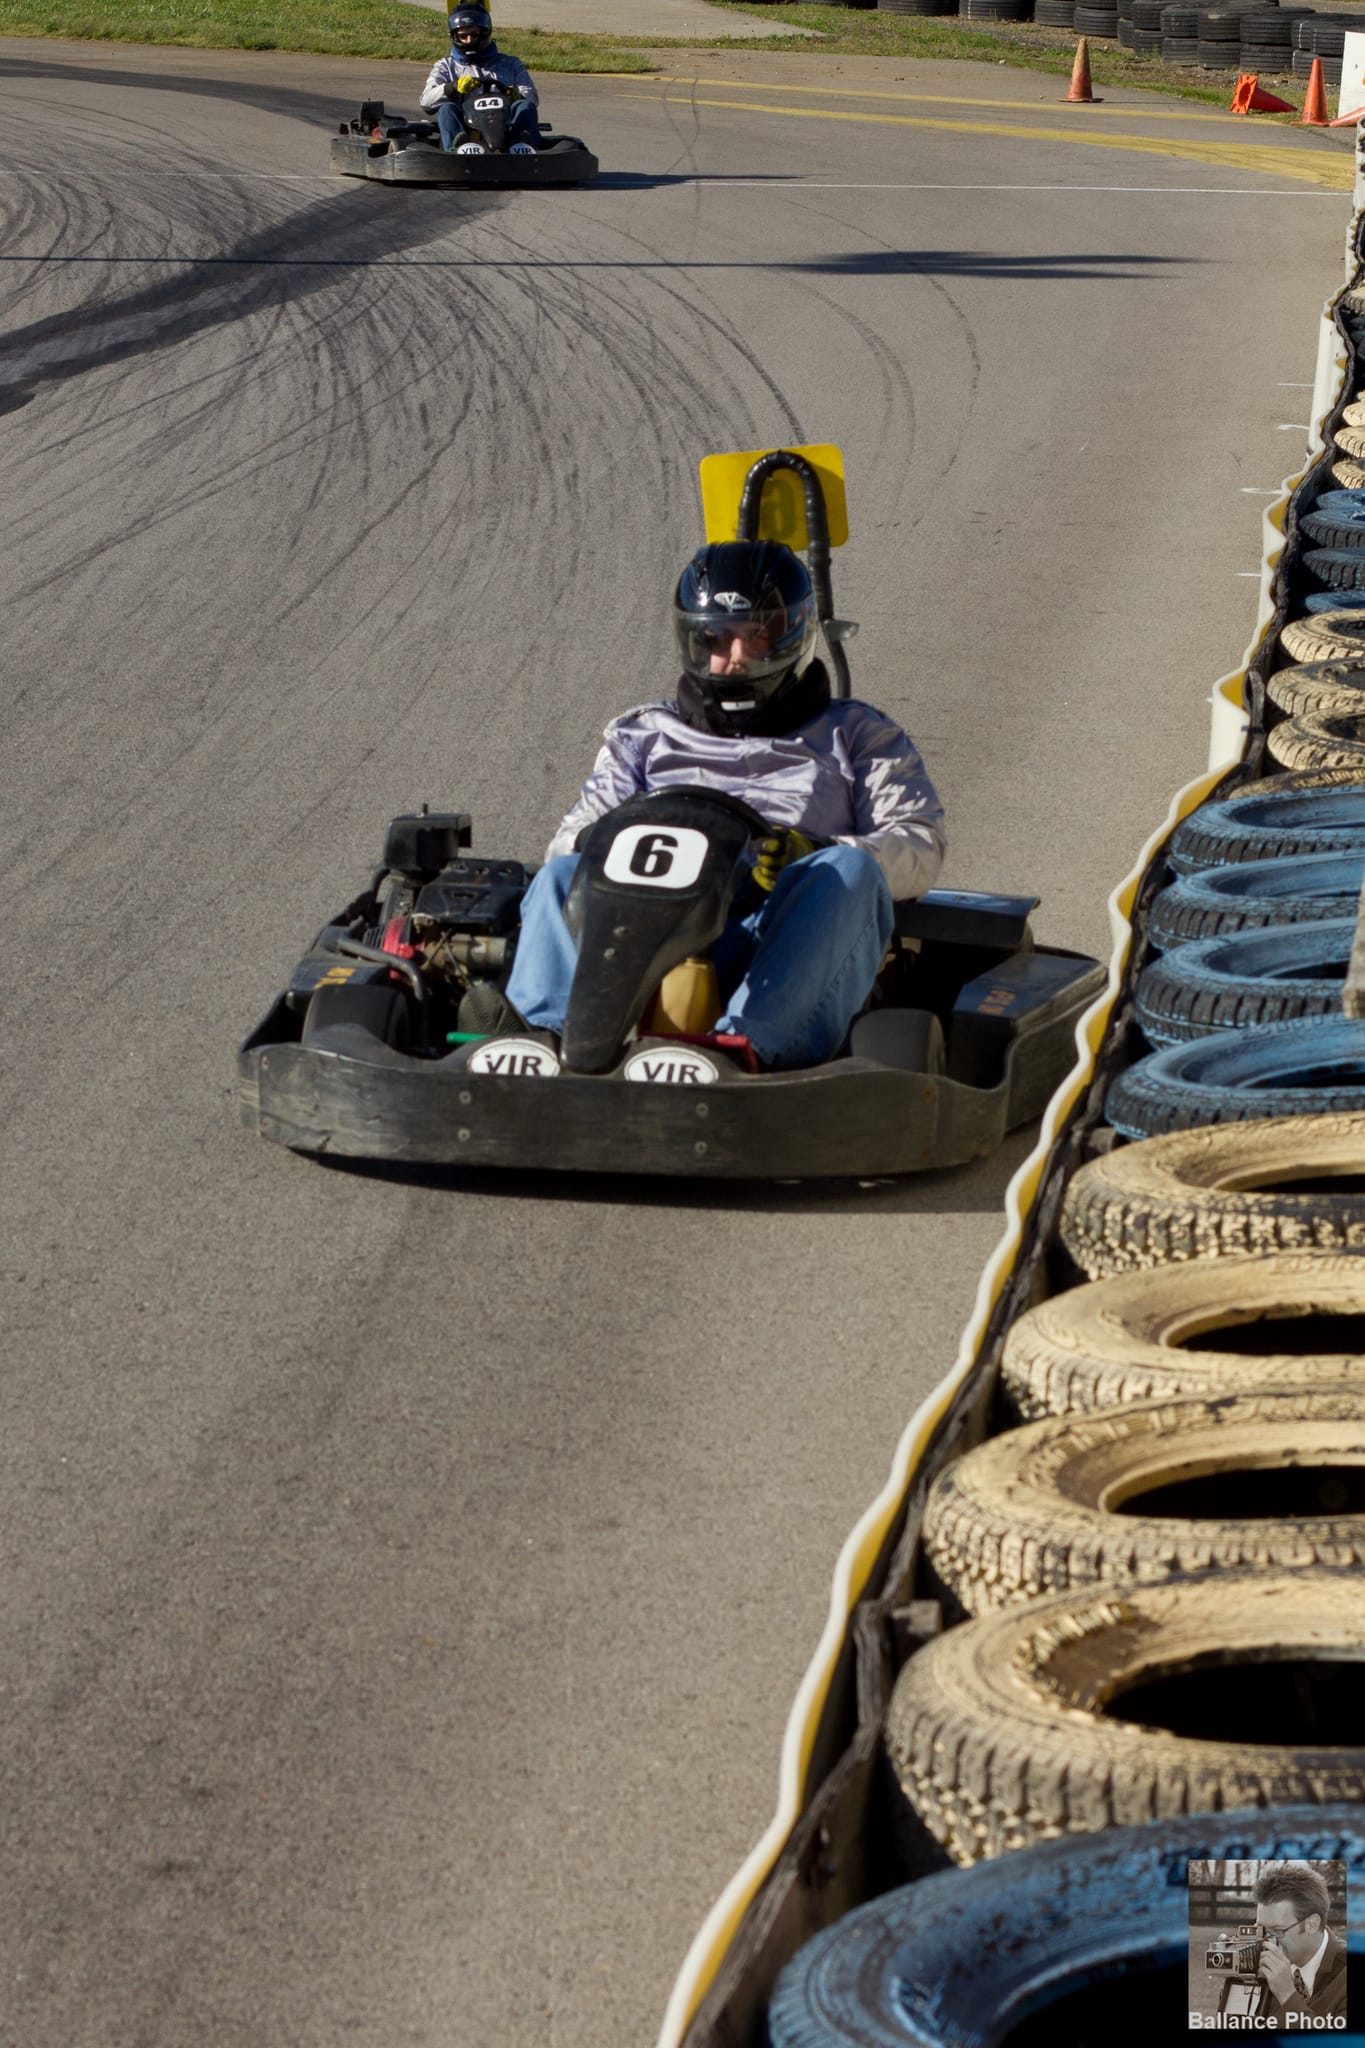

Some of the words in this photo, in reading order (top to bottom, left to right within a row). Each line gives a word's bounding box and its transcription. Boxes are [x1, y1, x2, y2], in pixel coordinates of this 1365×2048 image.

[477, 99, 500, 107] 44
[462, 147, 481, 155] VIR
[512, 147, 532, 155] VIR
[629, 833, 679, 878] 6
[484, 1054, 543, 1076] VIR
[642, 1061, 701, 1083] VIR
